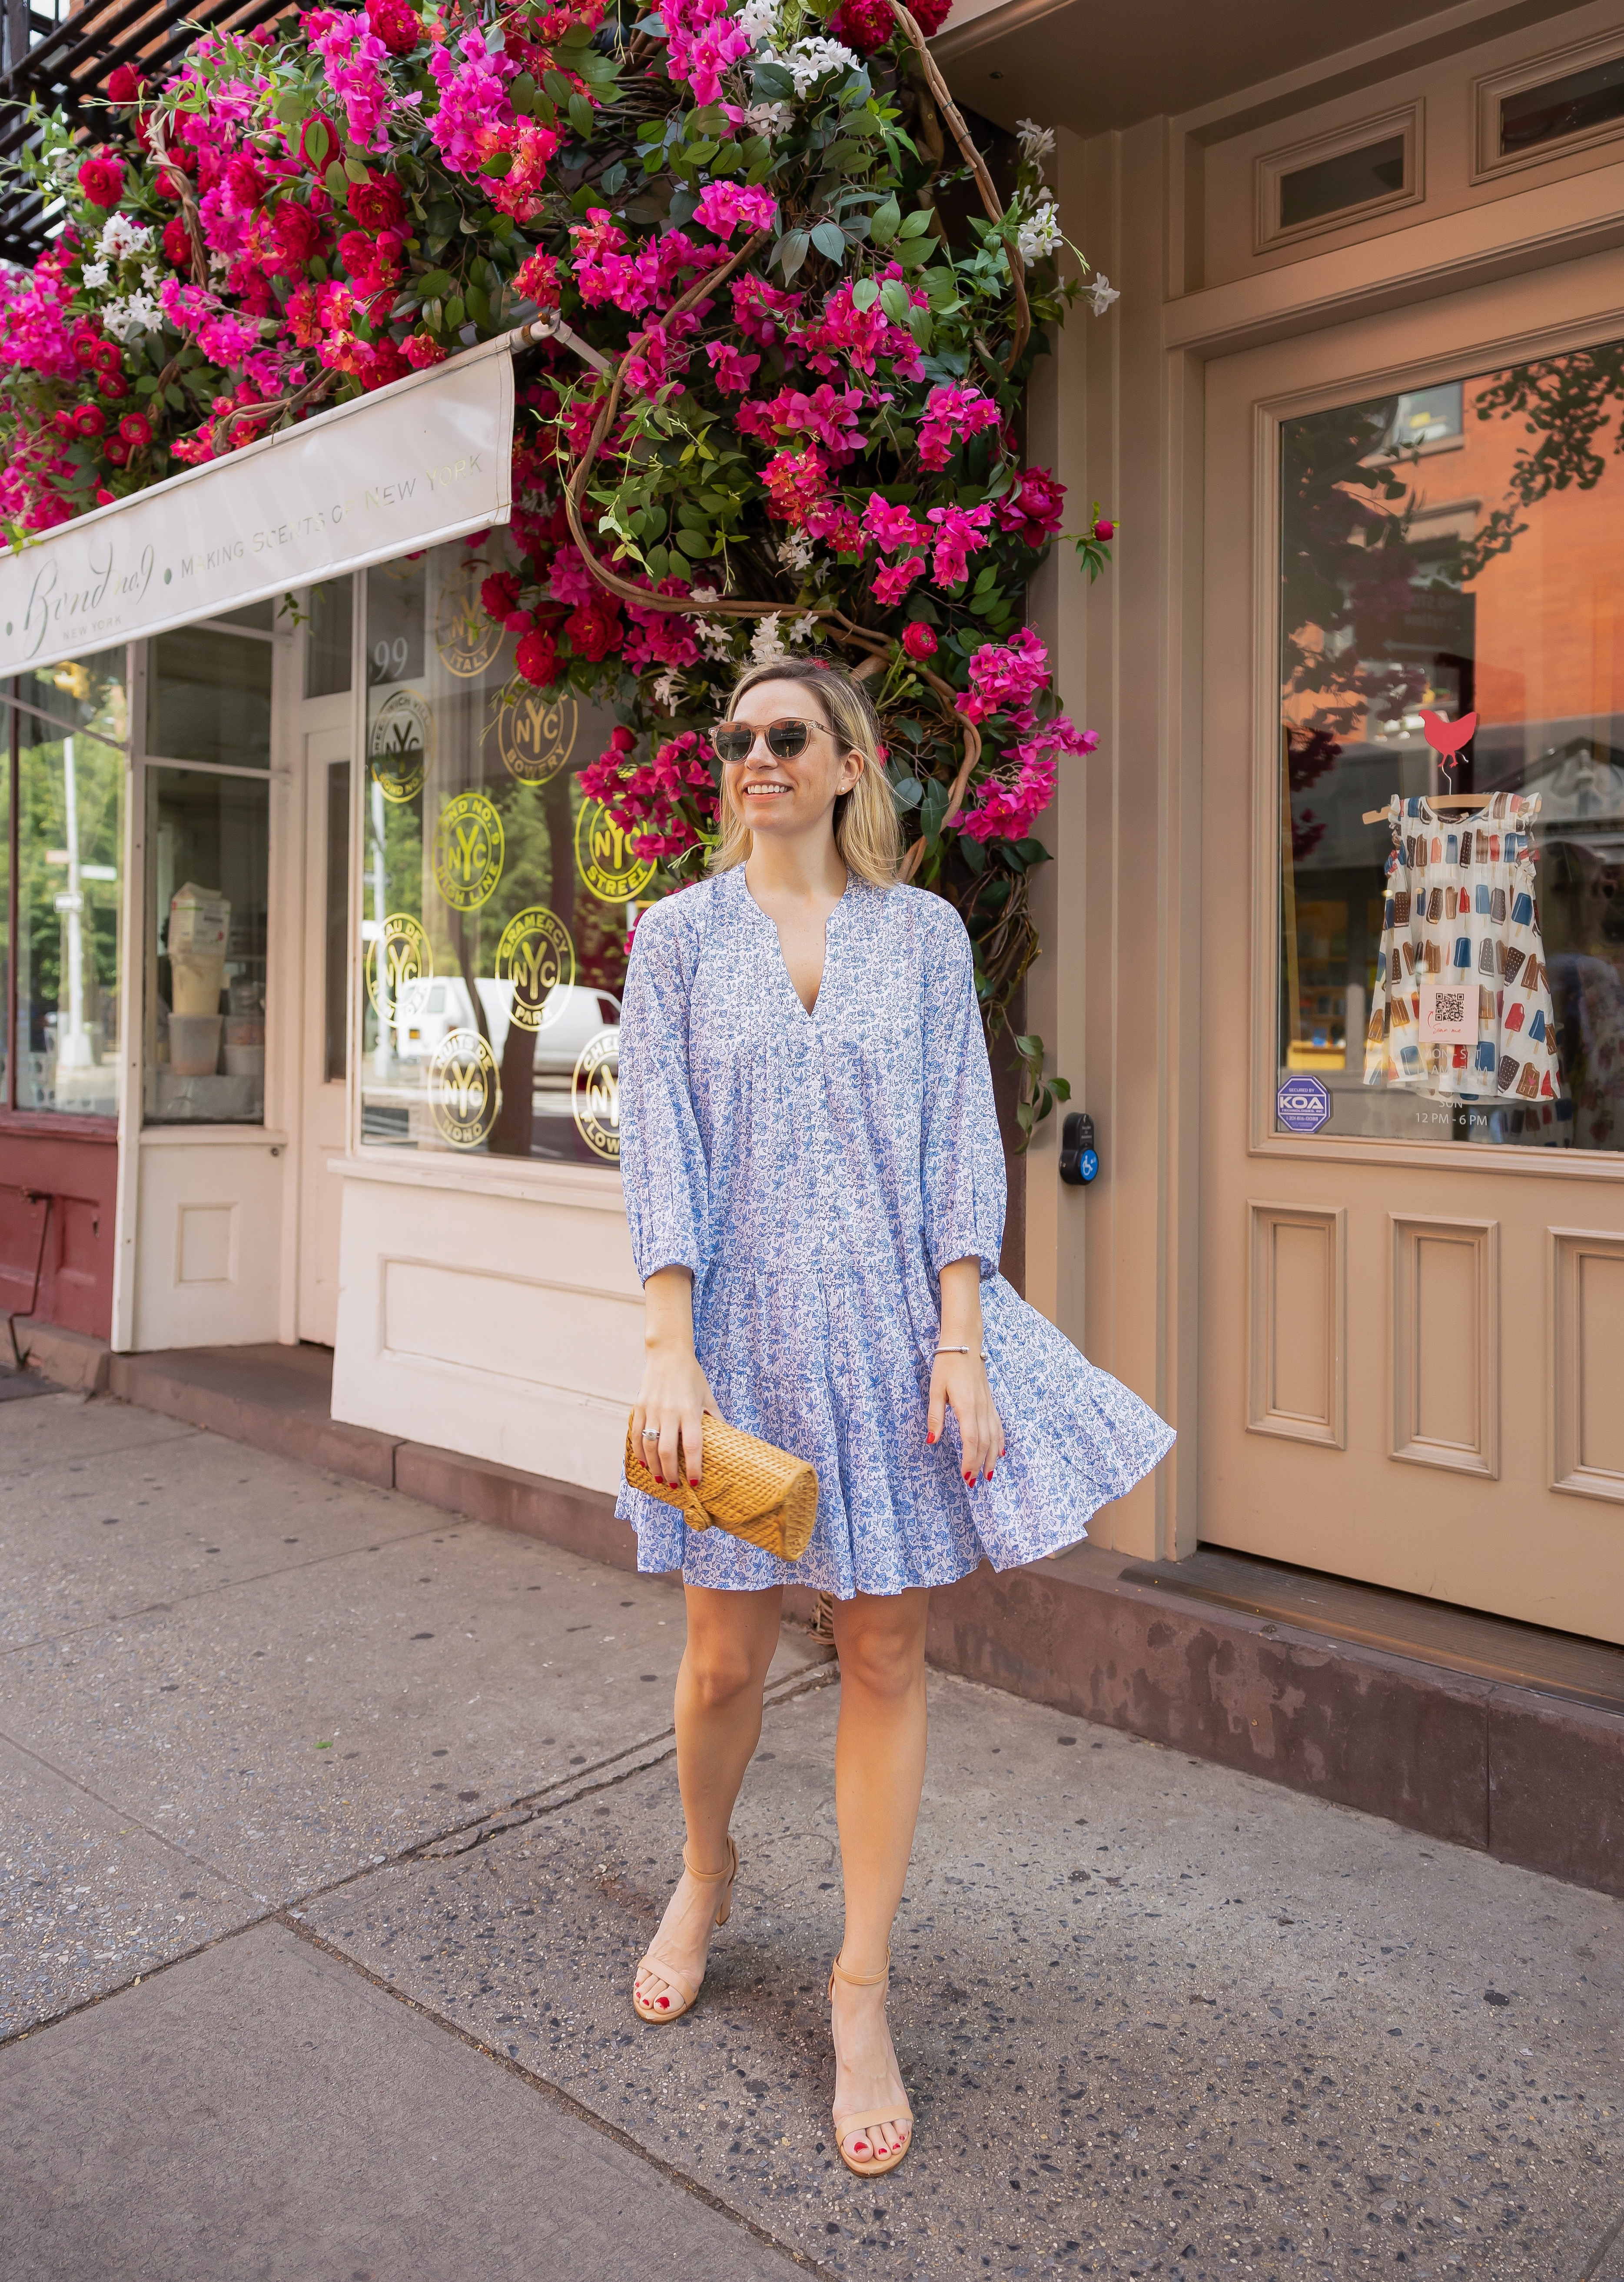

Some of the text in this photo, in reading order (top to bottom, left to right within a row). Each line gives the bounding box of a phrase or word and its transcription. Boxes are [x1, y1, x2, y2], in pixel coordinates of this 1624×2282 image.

[181, 452, 482, 578] MAKING SCENTS OF NEW YORK
[23, 539, 114, 659] Bond
[63, 614, 122, 641] NEW YORK
[369, 636, 408, 682] 99
[450, 647, 488, 670] ITALY
[516, 698, 559, 754] NYC
[506, 742, 565, 778] BOWERY
[448, 825, 487, 882] NYC
[438, 861, 499, 905] HIGH LINE
[587, 865, 648, 895] STREET
[383, 919, 423, 946] AU DE
[501, 913, 569, 958] GRAMERCY
[384, 944, 418, 999] NYC
[513, 940, 556, 1000] NYC
[515, 1004, 552, 1025] PARK
[436, 1034, 493, 1072] NUITS DE
[583, 1036, 619, 1071] CHEL
[1423, 1048, 1449, 1059] MON
[1460, 1048, 1481, 1060] ST
[444, 1060, 484, 1118] NYC
[591, 1064, 619, 1127] NY
[1280, 1096, 1324, 1109] KOA
[1439, 1099, 1462, 1108] SUN
[442, 1118, 483, 1142] NOHO
[580, 1110, 620, 1153] FLOW
[1416, 1112, 1428, 1124] 12
[1432, 1113, 1449, 1124] PM
[1459, 1114, 1466, 1125] 6
[1470, 1114, 1488, 1126] PM
